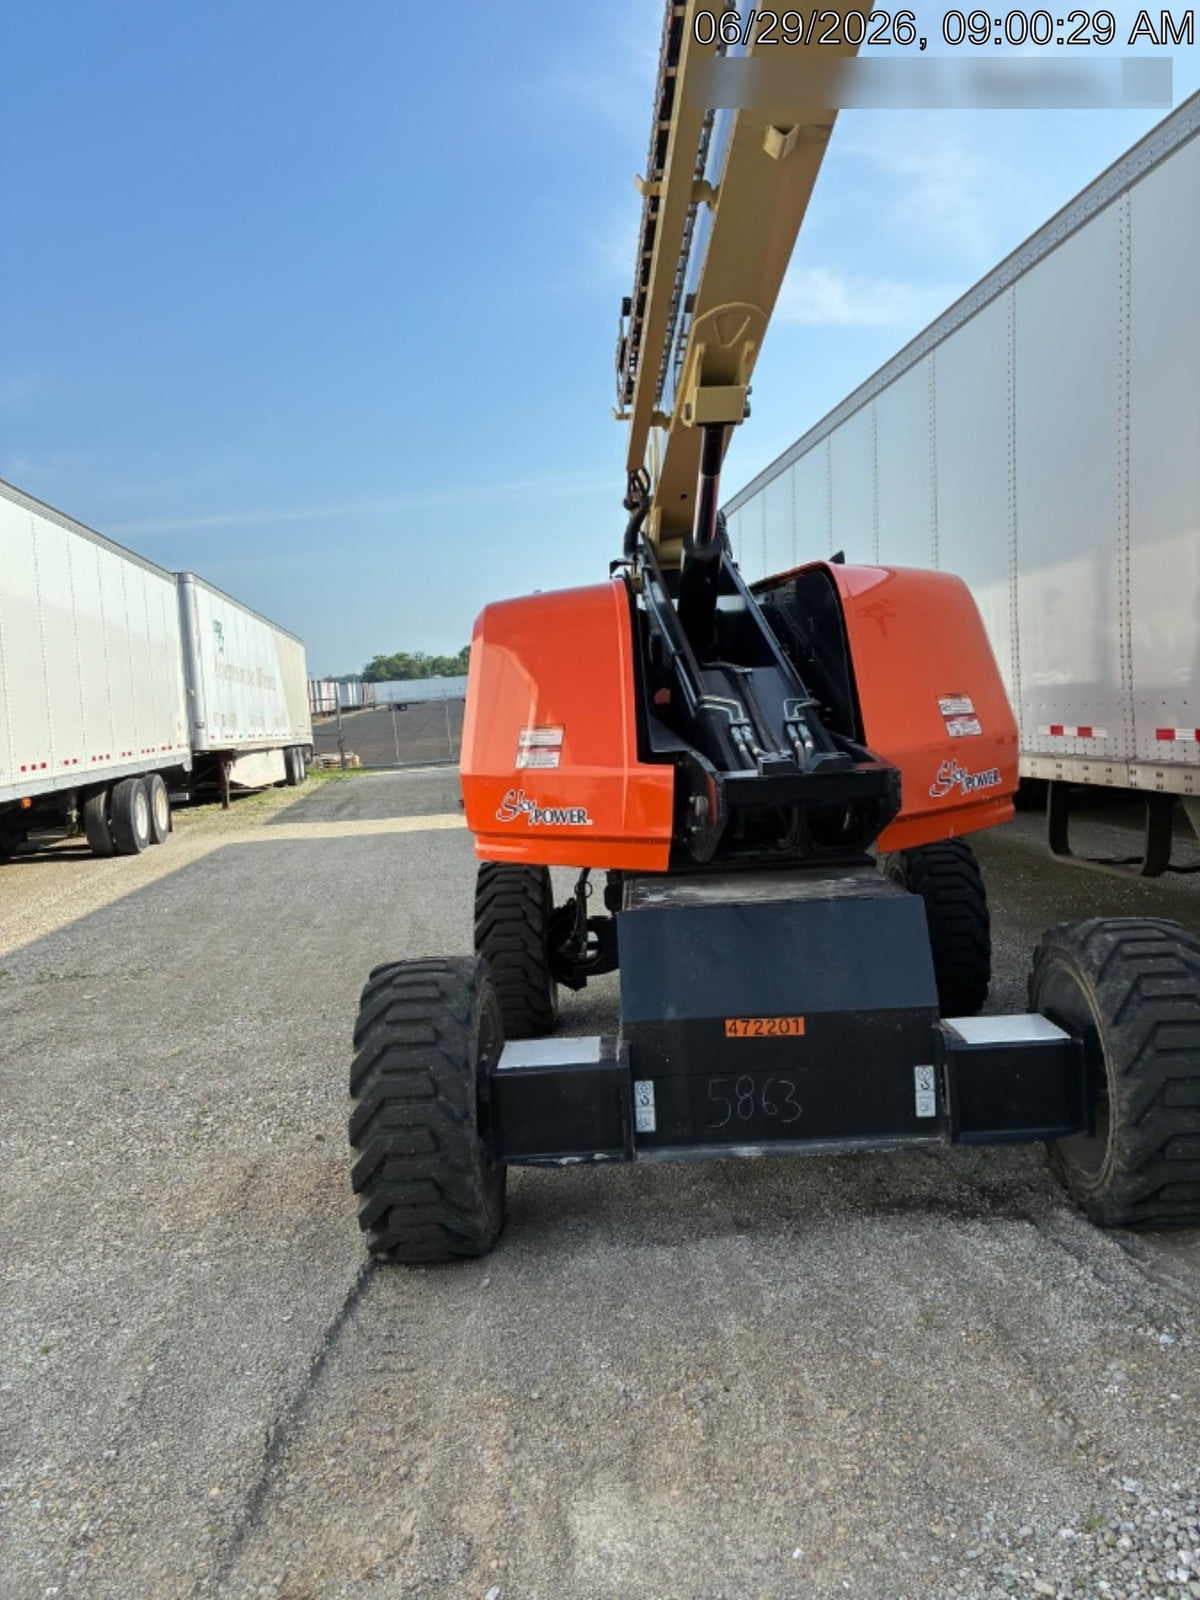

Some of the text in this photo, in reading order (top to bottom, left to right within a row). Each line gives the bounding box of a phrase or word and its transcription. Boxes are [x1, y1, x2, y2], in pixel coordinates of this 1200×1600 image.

[533, 807, 587, 825] POWER
[728, 1018, 801, 1036] 472201
[707, 1075, 803, 1128] 5863
